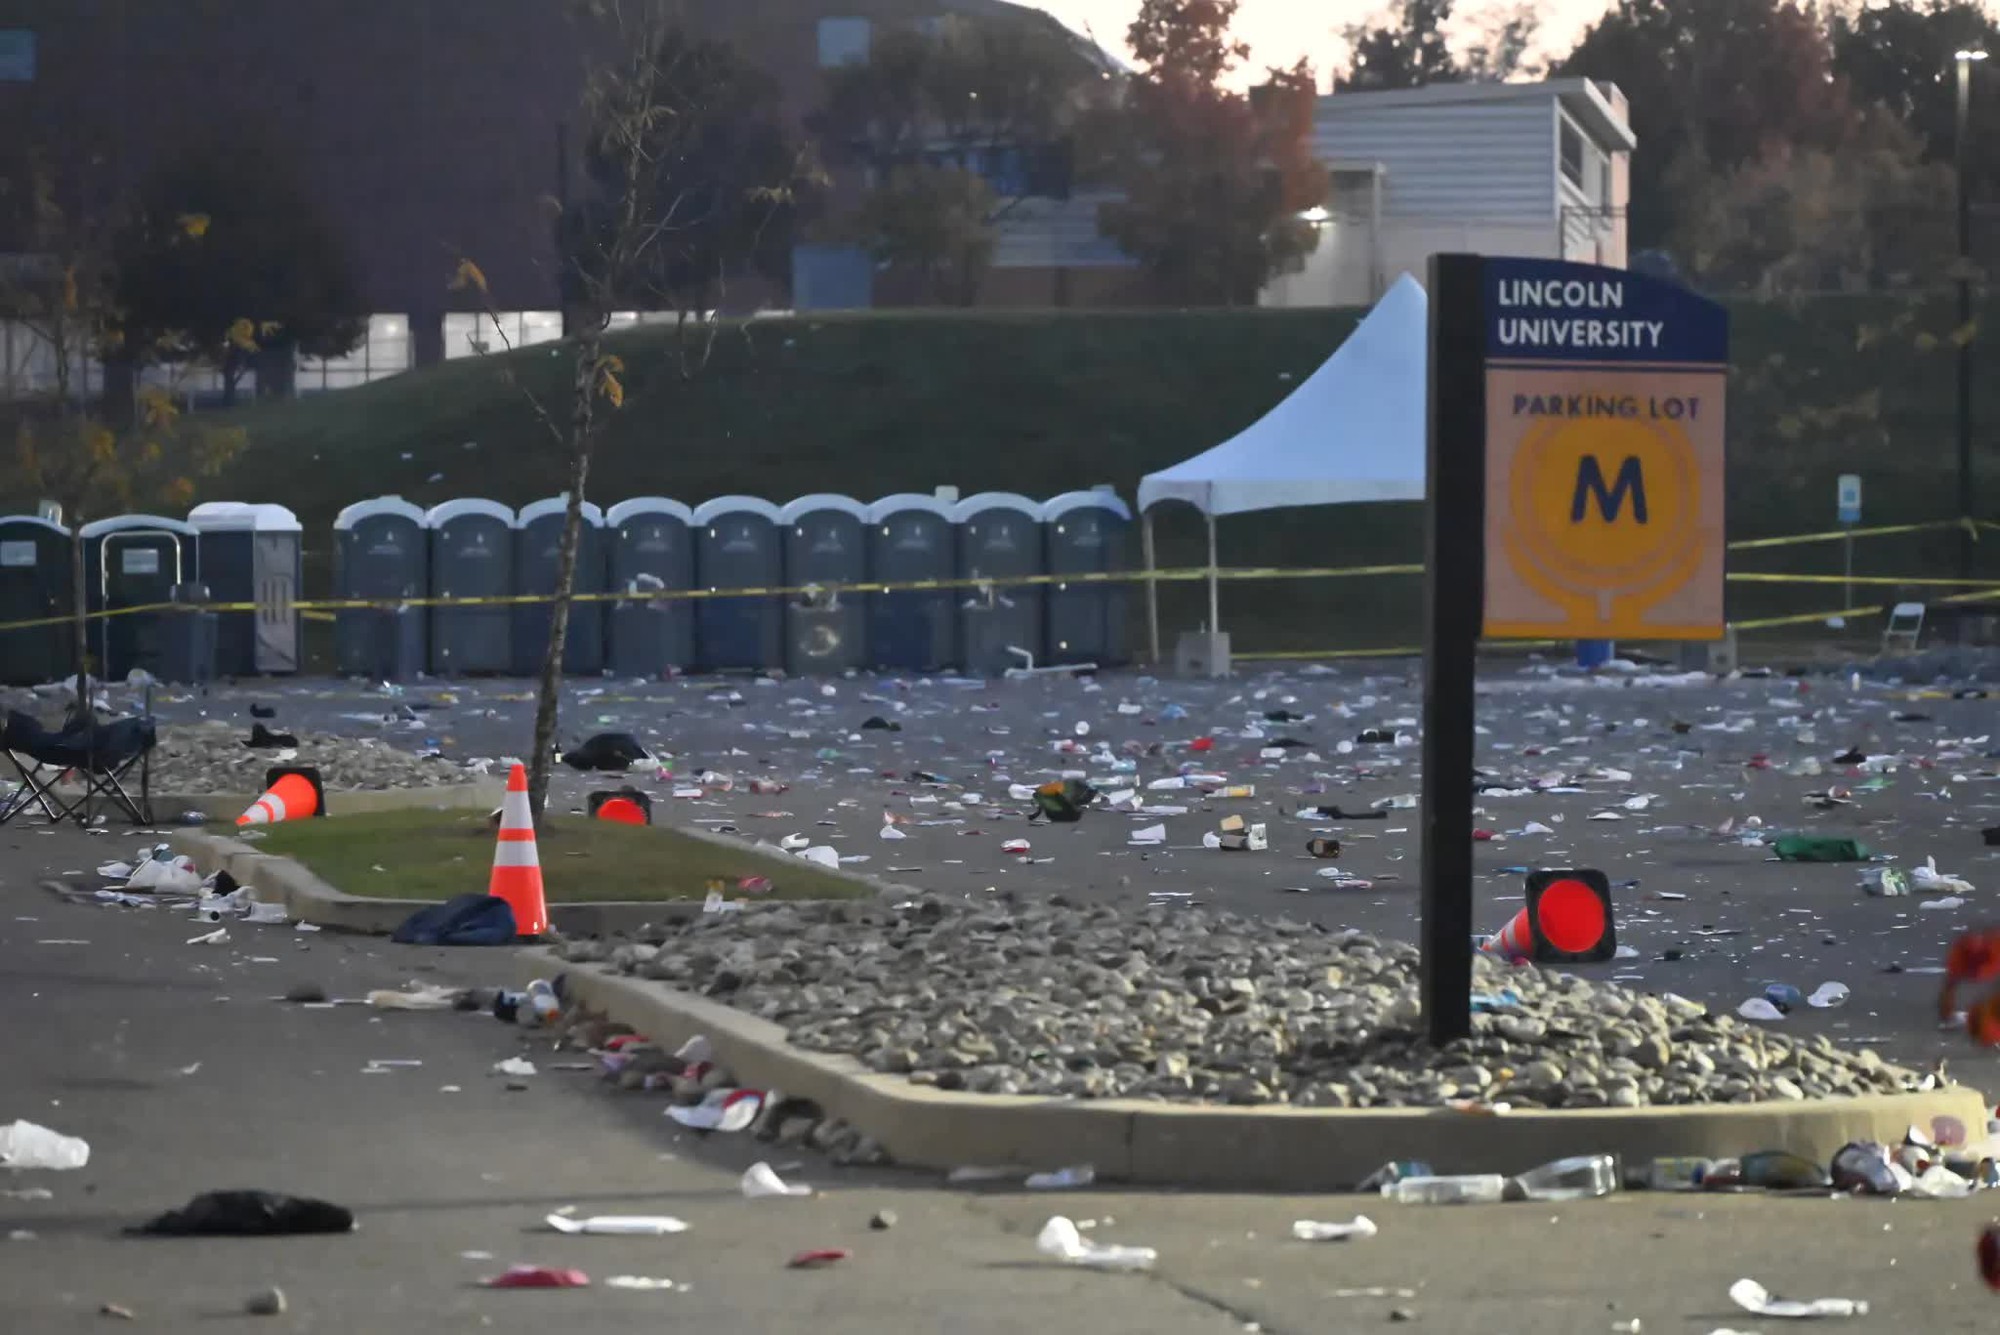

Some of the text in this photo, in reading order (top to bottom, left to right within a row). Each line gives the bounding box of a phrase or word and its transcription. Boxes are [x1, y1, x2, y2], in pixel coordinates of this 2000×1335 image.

[1498, 279, 1623, 309] LINCOLN
[1498, 318, 1664, 348] UNIVERSITY
[1512, 393, 1699, 420] PARKING LOT
[1570, 454, 1648, 524] M
